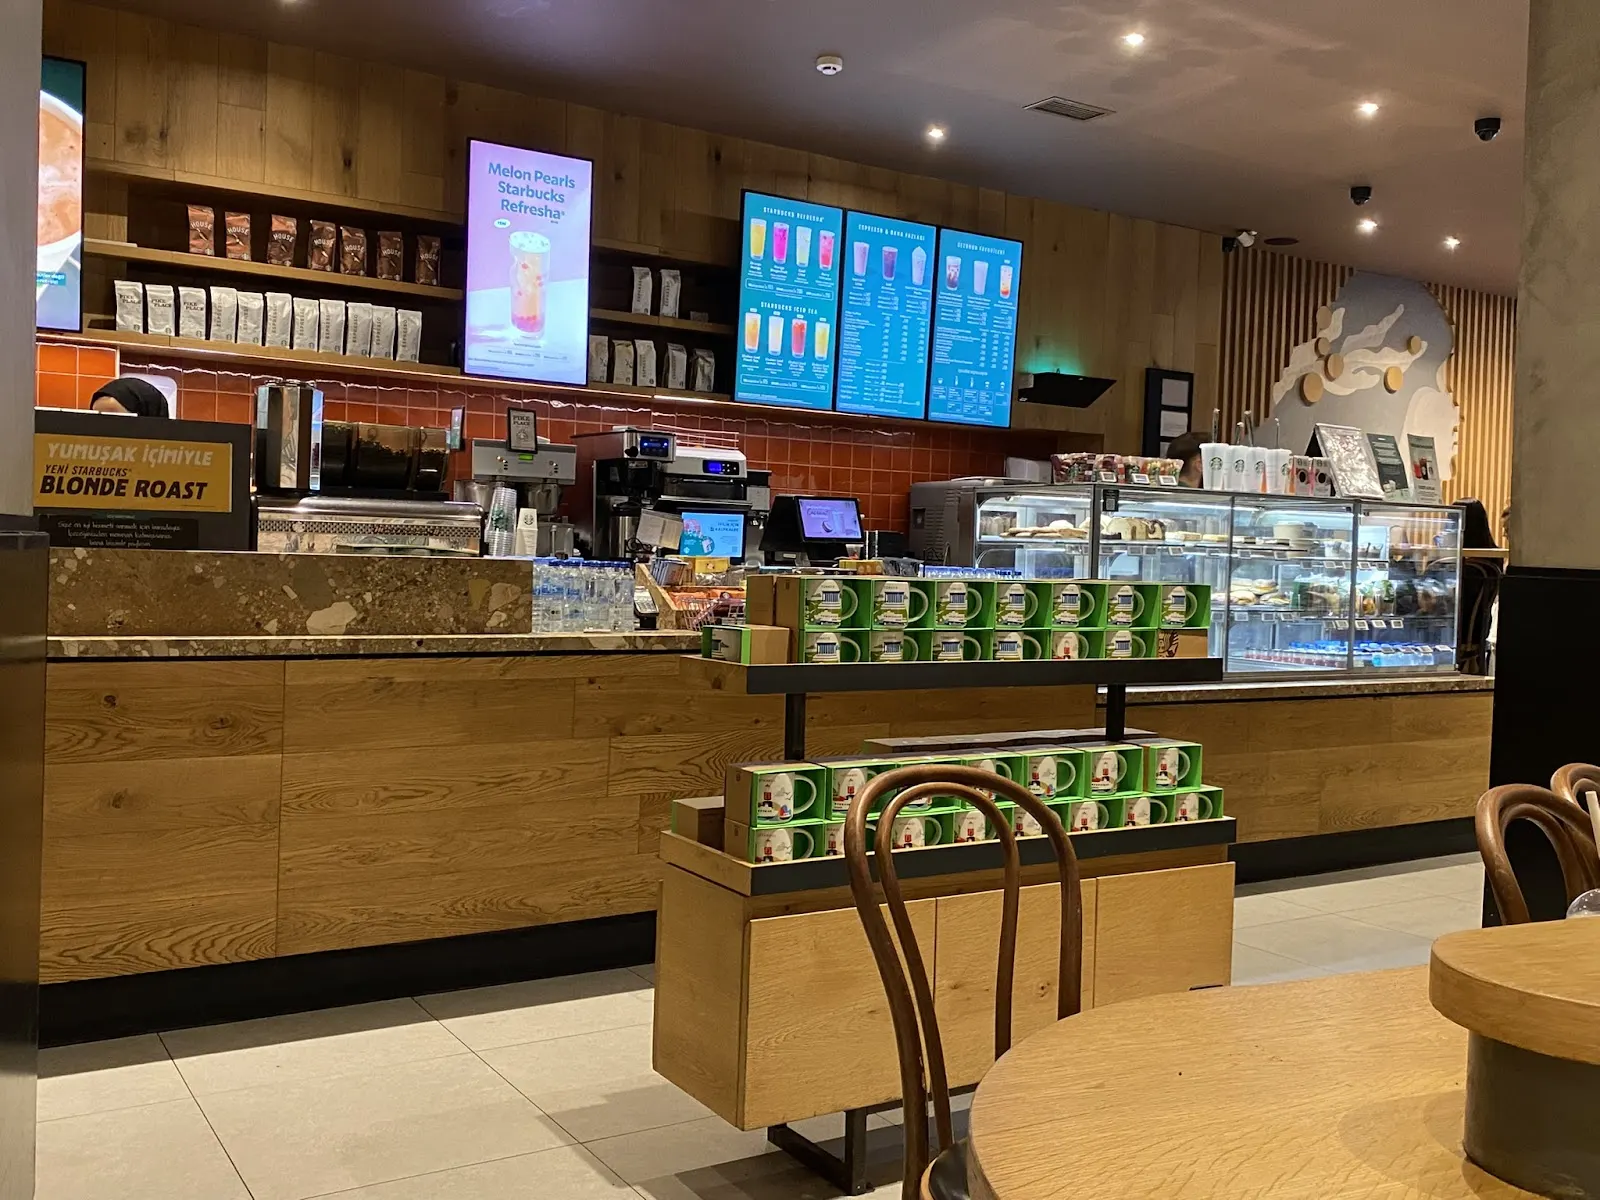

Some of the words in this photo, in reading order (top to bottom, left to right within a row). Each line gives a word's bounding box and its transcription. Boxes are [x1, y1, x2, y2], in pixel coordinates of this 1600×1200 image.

[488, 162, 531, 181] Melon
[534, 170, 576, 189] Pearls
[498, 181, 565, 203] Starbucks
[190, 221, 213, 230] HOUSE
[226, 226, 249, 235] HOUSE
[273, 233, 295, 243] HOUSE
[344, 244, 365, 253] HOUSE
[382, 248, 401, 257] HOUSE
[760, 301, 792, 311] STARBUCKS
[48, 442, 136, 464] YUMUŞAK
[44, 463, 69, 475] YENİ
[71, 465, 129, 477] STARBUCKS
[40, 475, 129, 497] BLONDE
[134, 480, 208, 500] ROAST
